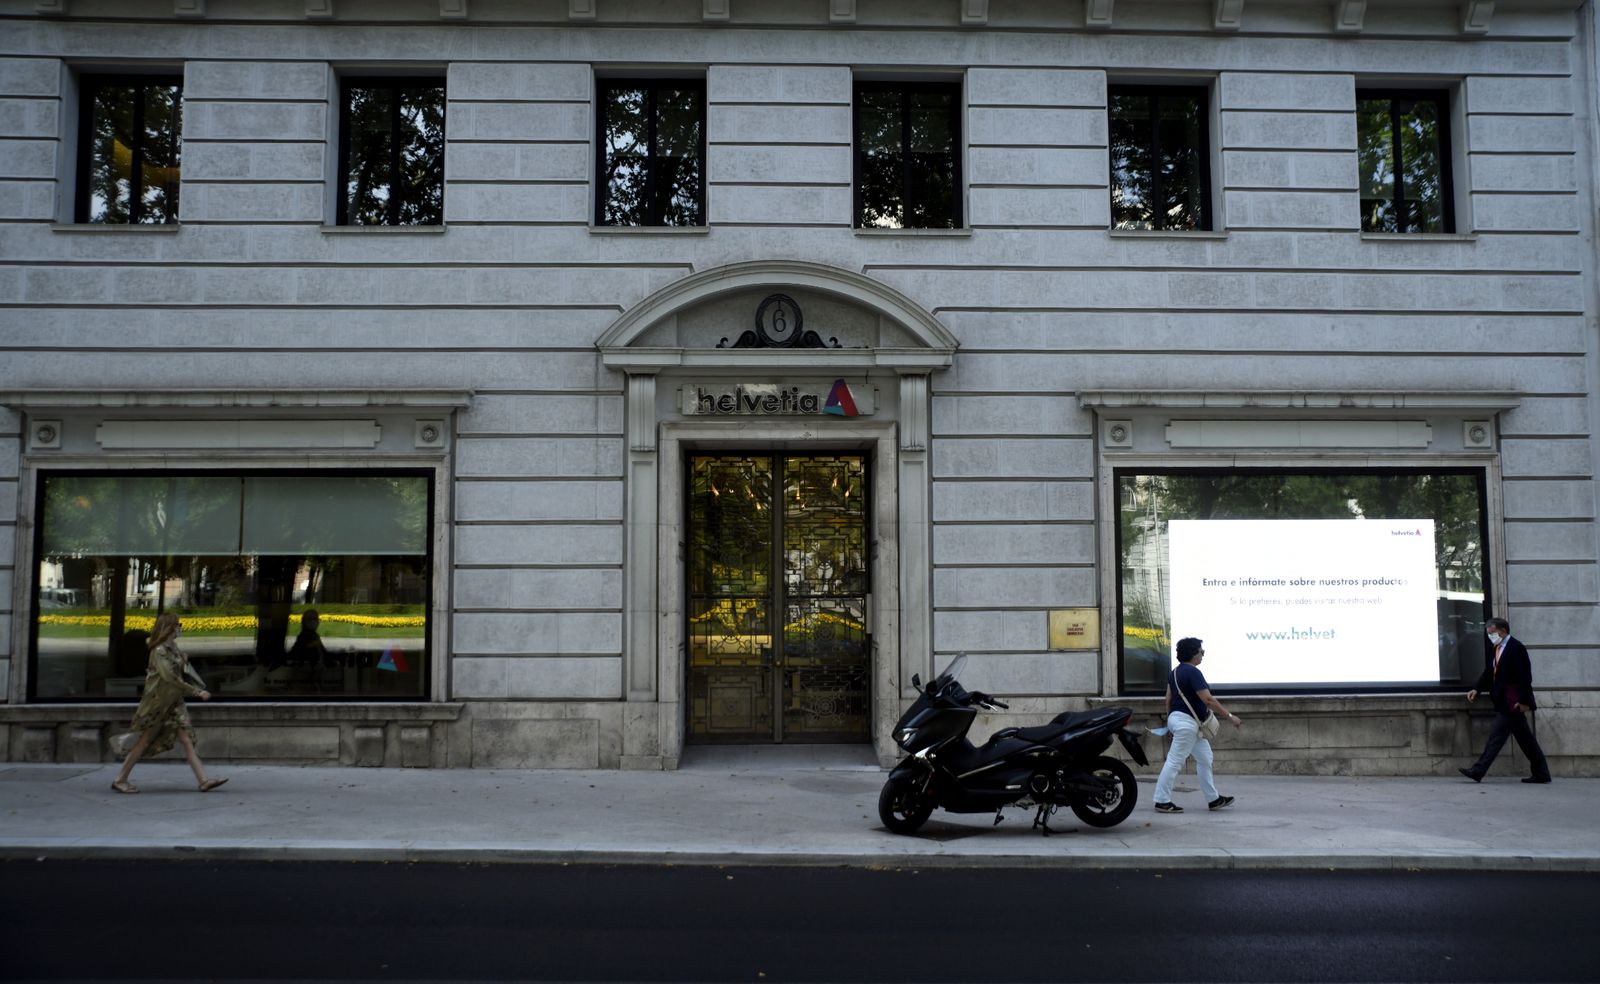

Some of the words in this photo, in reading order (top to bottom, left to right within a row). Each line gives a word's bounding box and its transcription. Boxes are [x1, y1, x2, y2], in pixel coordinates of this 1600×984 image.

[773, 309, 786, 333] 6
[697, 386, 819, 413] helvetia
[1202, 578, 1228, 587] Entra
[1230, 579, 1237, 587] e
[1239, 577, 1286, 587] infórmate
[1289, 576, 1316, 587] sobre
[1319, 578, 1359, 587] nuestros
[1361, 576, 1408, 588] productos
[1240, 597, 1247, 605] lo
[1366, 595, 1383, 605] web
